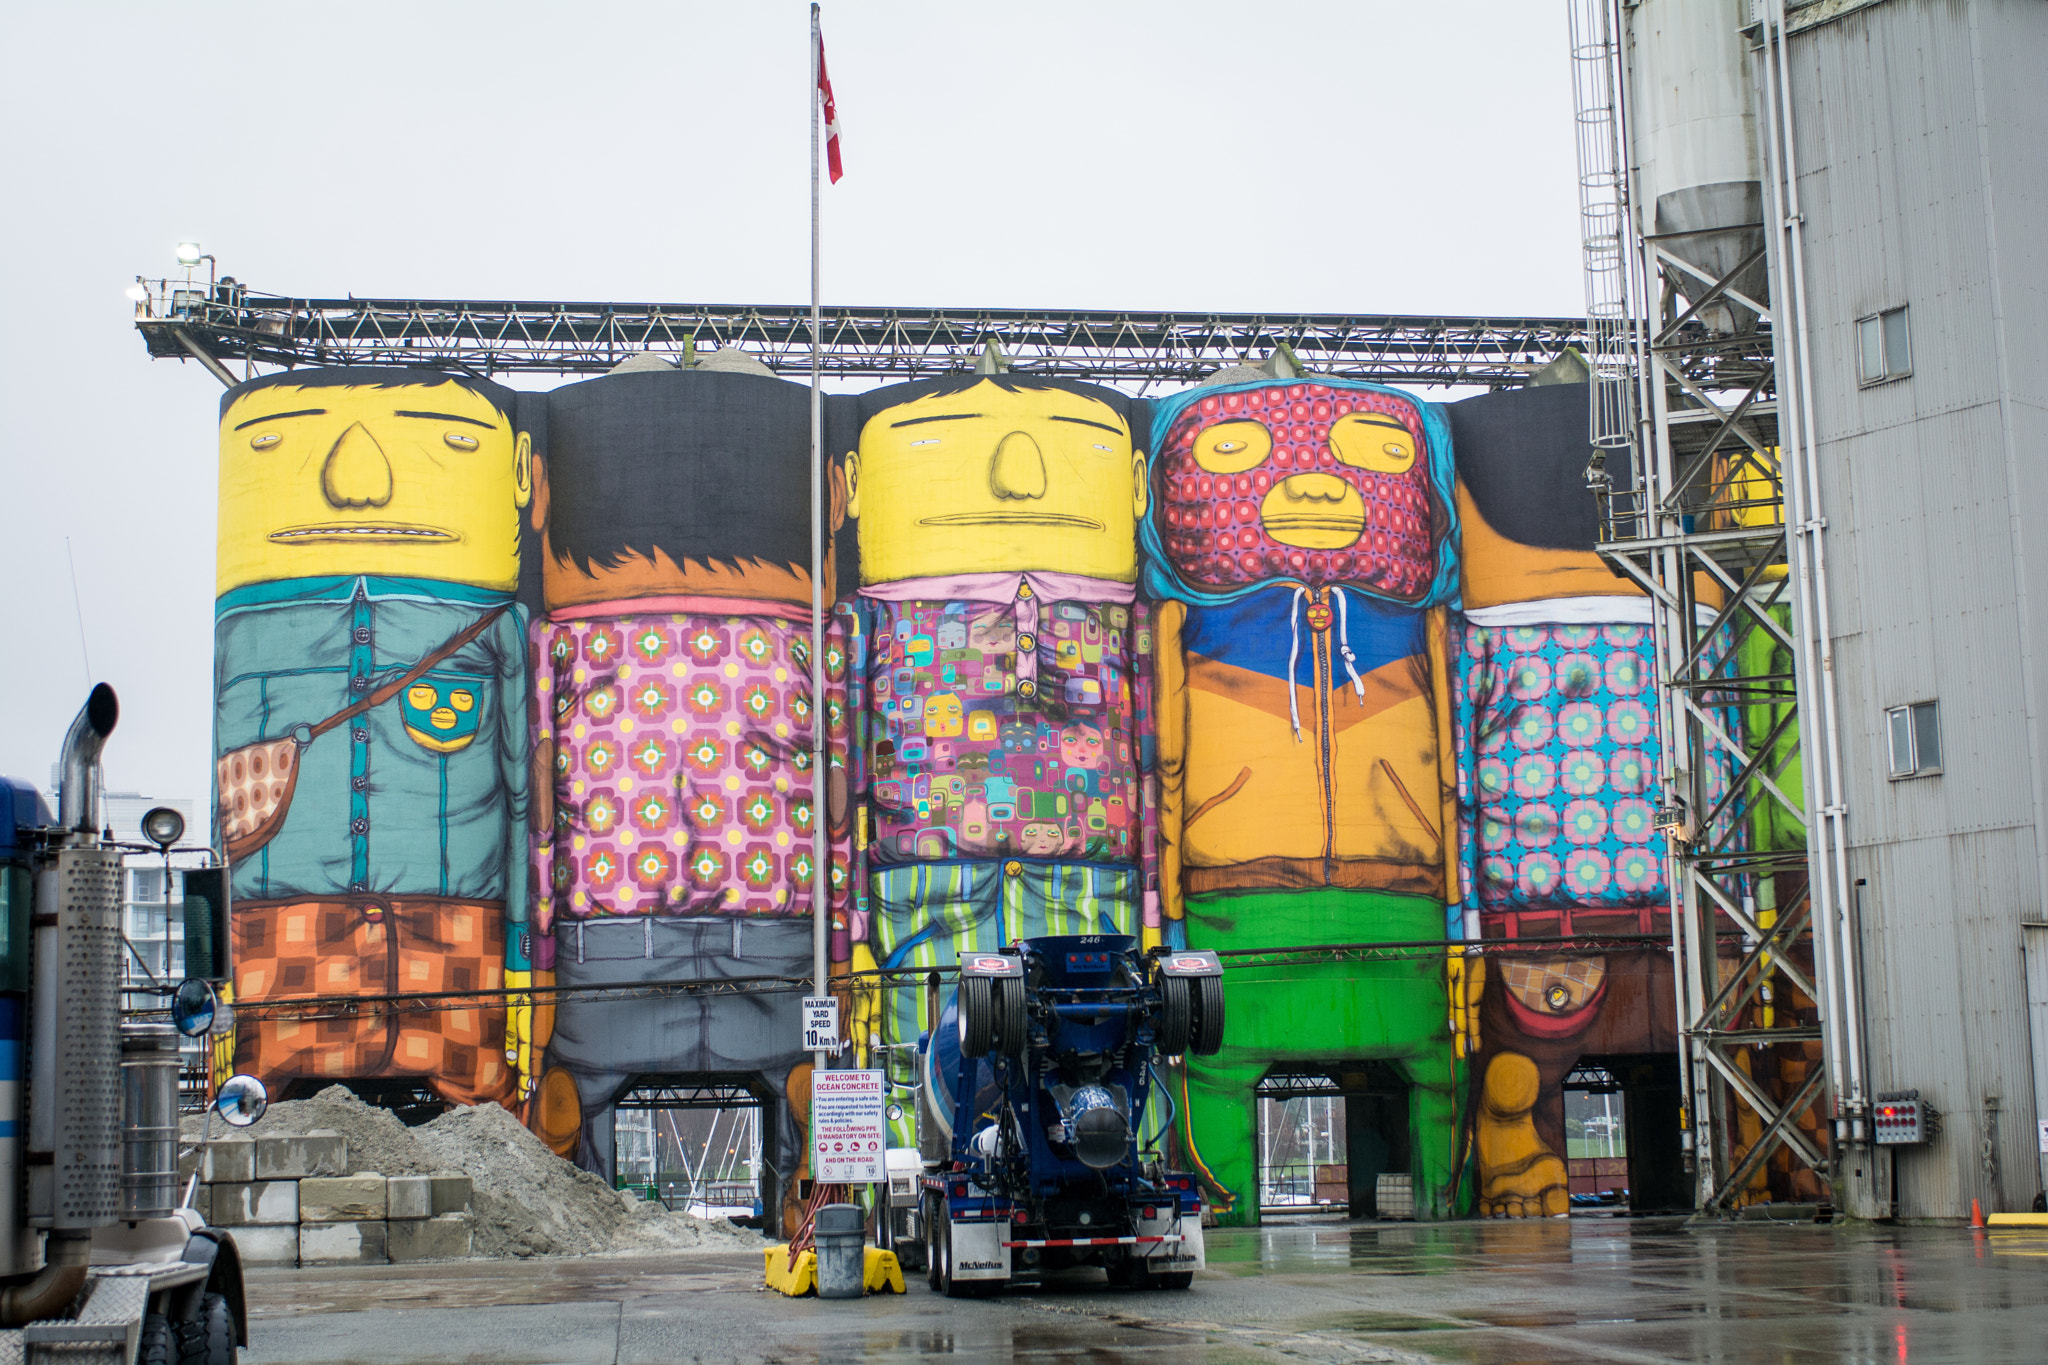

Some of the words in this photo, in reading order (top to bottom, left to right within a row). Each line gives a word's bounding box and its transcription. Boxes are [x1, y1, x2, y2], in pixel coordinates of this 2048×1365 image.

[1080, 936, 1100, 944] 246
[805, 1000, 836, 1008] MAXIMUM
[812, 1010, 829, 1018] YARD
[810, 1020, 831, 1028] SPEED
[805, 1030, 818, 1046] 10
[816, 1083, 841, 1091] OCEAN
[841, 1082, 880, 1090] CONCRETE
